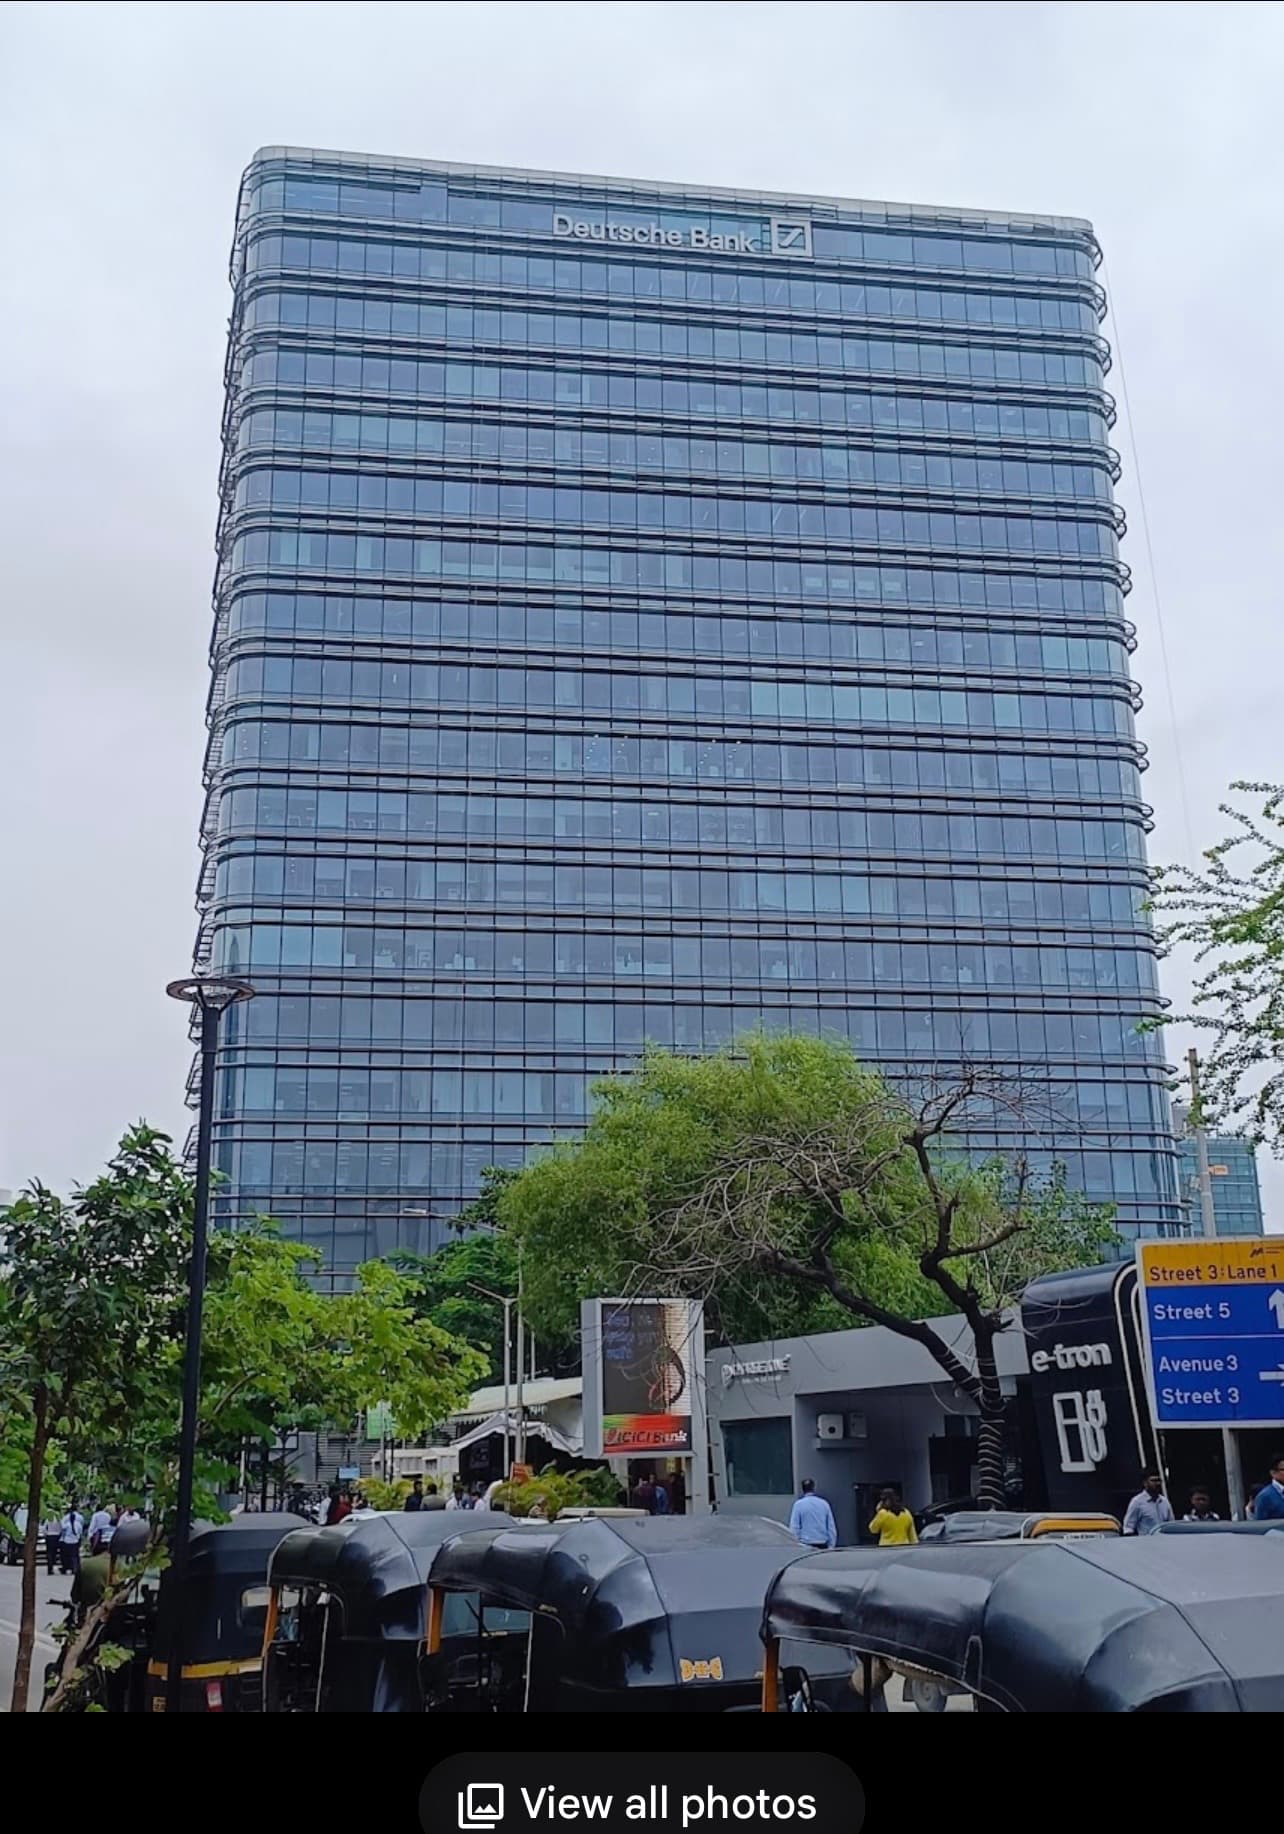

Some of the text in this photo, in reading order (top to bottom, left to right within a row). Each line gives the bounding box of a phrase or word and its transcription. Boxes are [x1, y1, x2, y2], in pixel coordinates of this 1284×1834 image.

[552, 213, 756, 253] Deutsche Bank
[1149, 1265, 1203, 1281] Street
[1227, 1264, 1266, 1279] Lane
[1270, 1263, 1278, 1278] 1
[1153, 1302, 1231, 1320] Street 5
[1031, 1343, 1113, 1373] e-tron
[1159, 1354, 1239, 1373] Avenue 3
[1161, 1387, 1240, 1405] Street 3
[617, 1430, 649, 1444] ICICI
